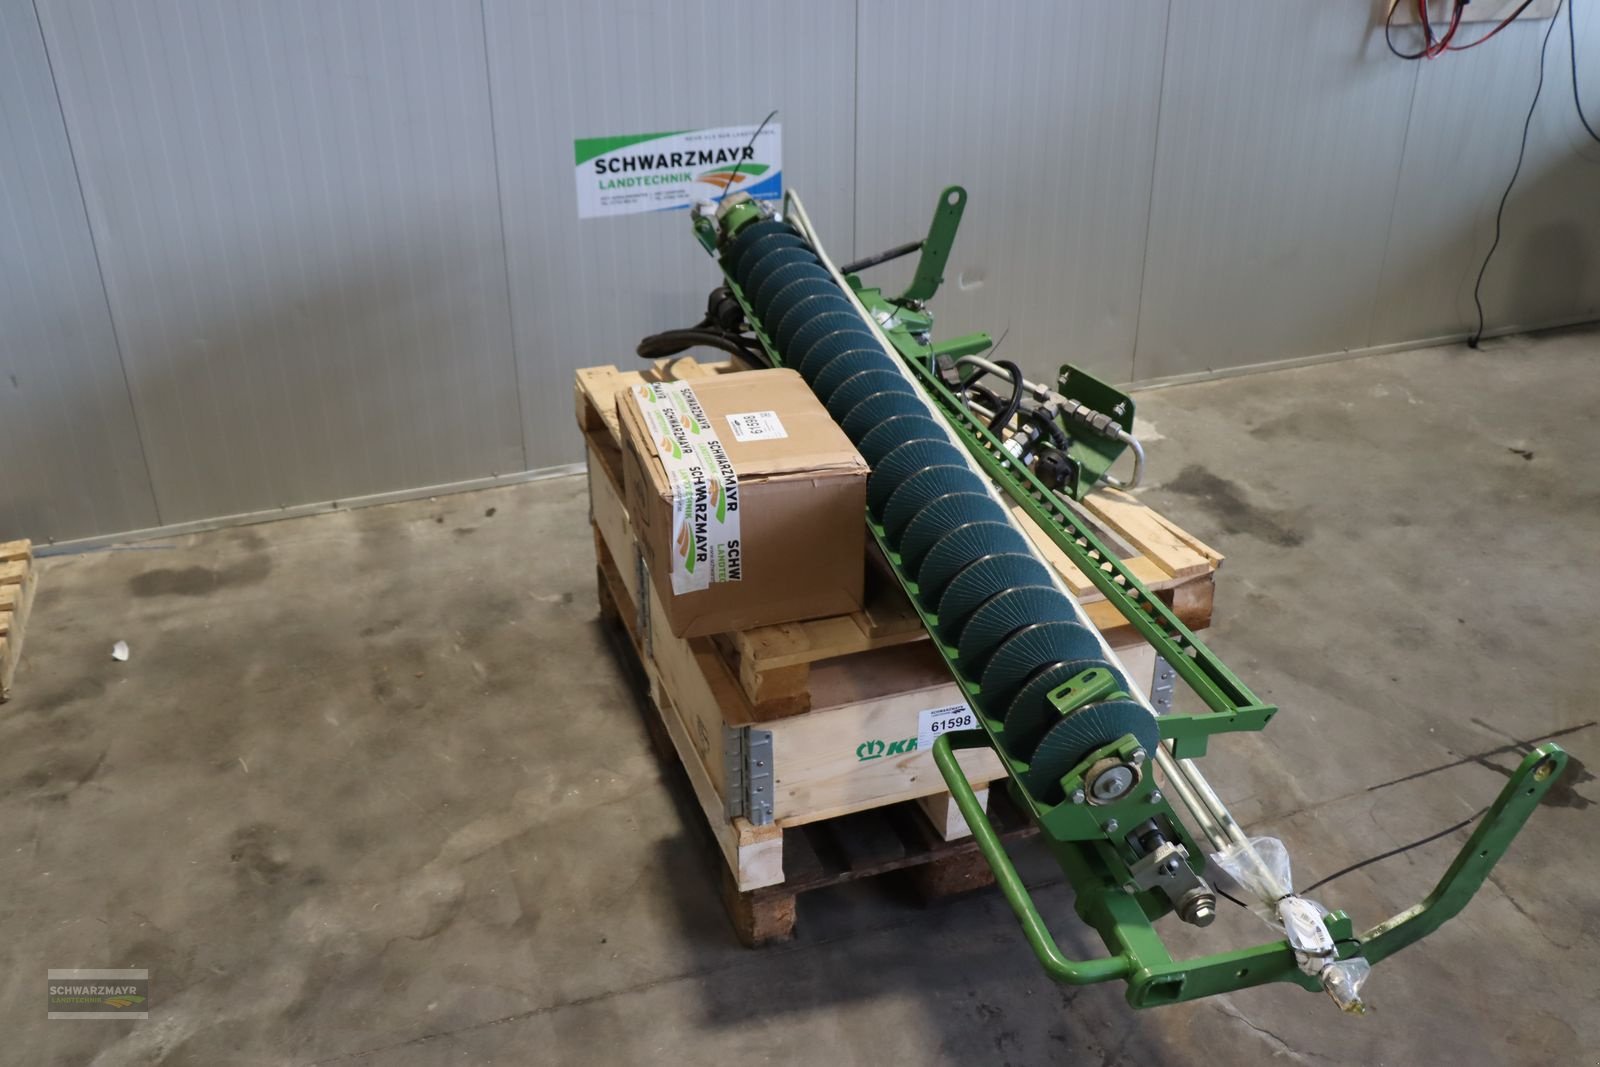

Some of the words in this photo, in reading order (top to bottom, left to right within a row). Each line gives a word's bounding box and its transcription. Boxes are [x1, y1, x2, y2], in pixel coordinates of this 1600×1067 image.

[594, 146, 754, 175] SCHWARZMAYR
[598, 172, 693, 190] LANDTECHNIK
[679, 388, 711, 431] SCHWARZMAYR
[662, 407, 693, 455] SCHWARZMAYR
[707, 440, 739, 512] SCHWARZMAYR
[689, 465, 709, 563] SCHWARZMAYR
[727, 539, 741, 581] SCHW
[931, 714, 972, 732] 61598
